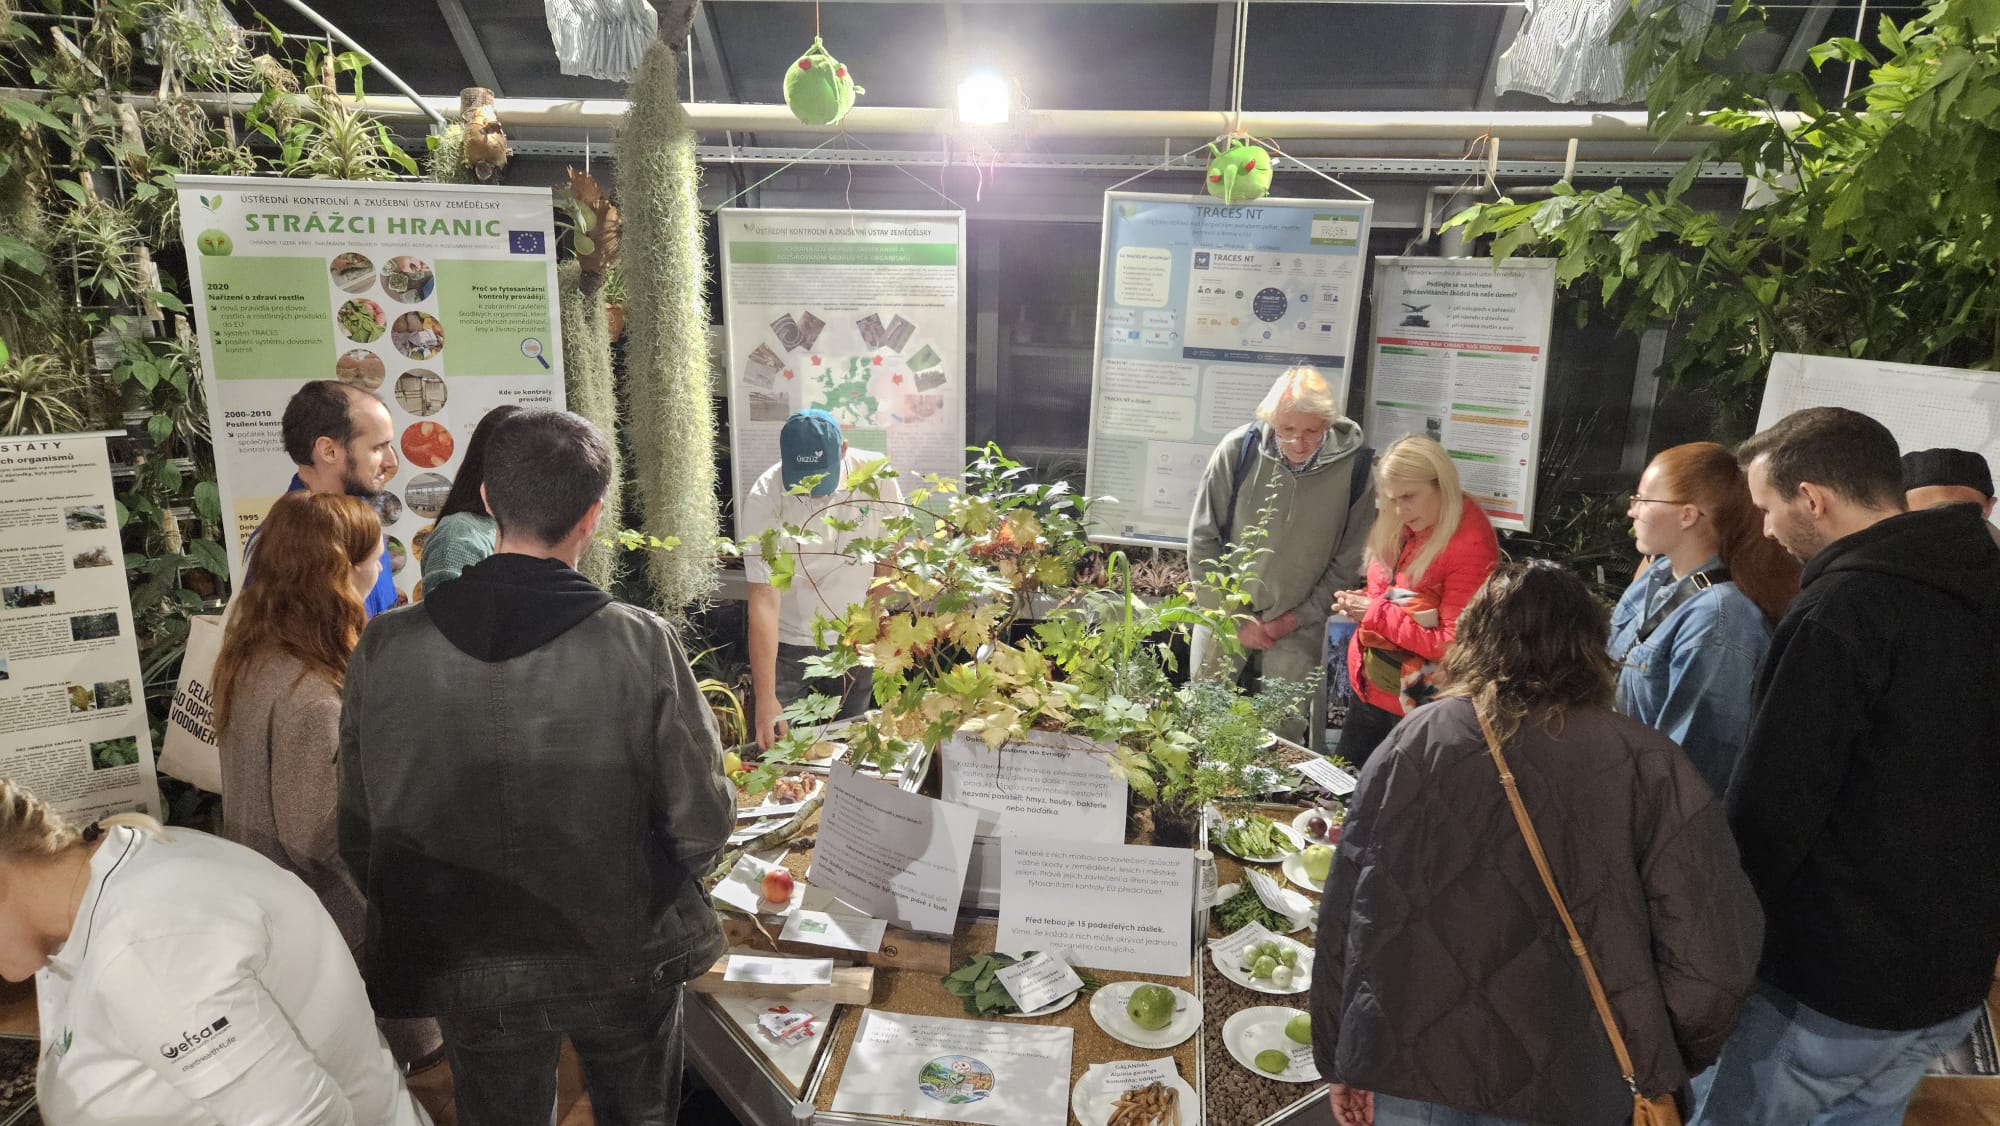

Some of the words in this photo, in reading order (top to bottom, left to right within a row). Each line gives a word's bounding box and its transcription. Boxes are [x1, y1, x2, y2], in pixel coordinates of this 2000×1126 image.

[240, 192, 288, 204] ÚSTŘEDNÍ
[293, 196, 349, 206] KONTROLNÍ
[353, 198, 360, 206] A
[364, 197, 409, 207] ZKUŠEBNÍ
[413, 198, 441, 208] ÚSTAV
[446, 199, 500, 210] ZEMĚDĚLSKÝ
[1196, 207, 1242, 219] TRACES
[1246, 209, 1264, 220] NT
[245, 211, 375, 234] STRÁŽCI
[387, 216, 501, 237] HRANIC
[1214, 253, 1242, 262] TRACES
[1244, 255, 1255, 263] NT
[207, 283, 230, 291] 2020
[499, 285, 545, 293] fytosanitární
[208, 293, 243, 301] Nařízení
[478, 293, 509, 301] kontroly
[17, 452, 74, 464] organismů
[187, 679, 214, 709] CELK
[185, 698, 216, 728] ODPIS
[171, 706, 220, 747] VODOMER
[961, 790, 990, 798] nezvaní
[1076, 799, 1107, 809] bakterie
[1005, 804, 1025, 812] nebo
[1025, 916, 1042, 924] Před
[1043, 917, 1066, 926] tebou
[1067, 919, 1075, 928] je
[1077, 920, 1086, 928] 15
[1087, 921, 1136, 931] podezřelých
[178, 1026, 213, 1052] efsa
